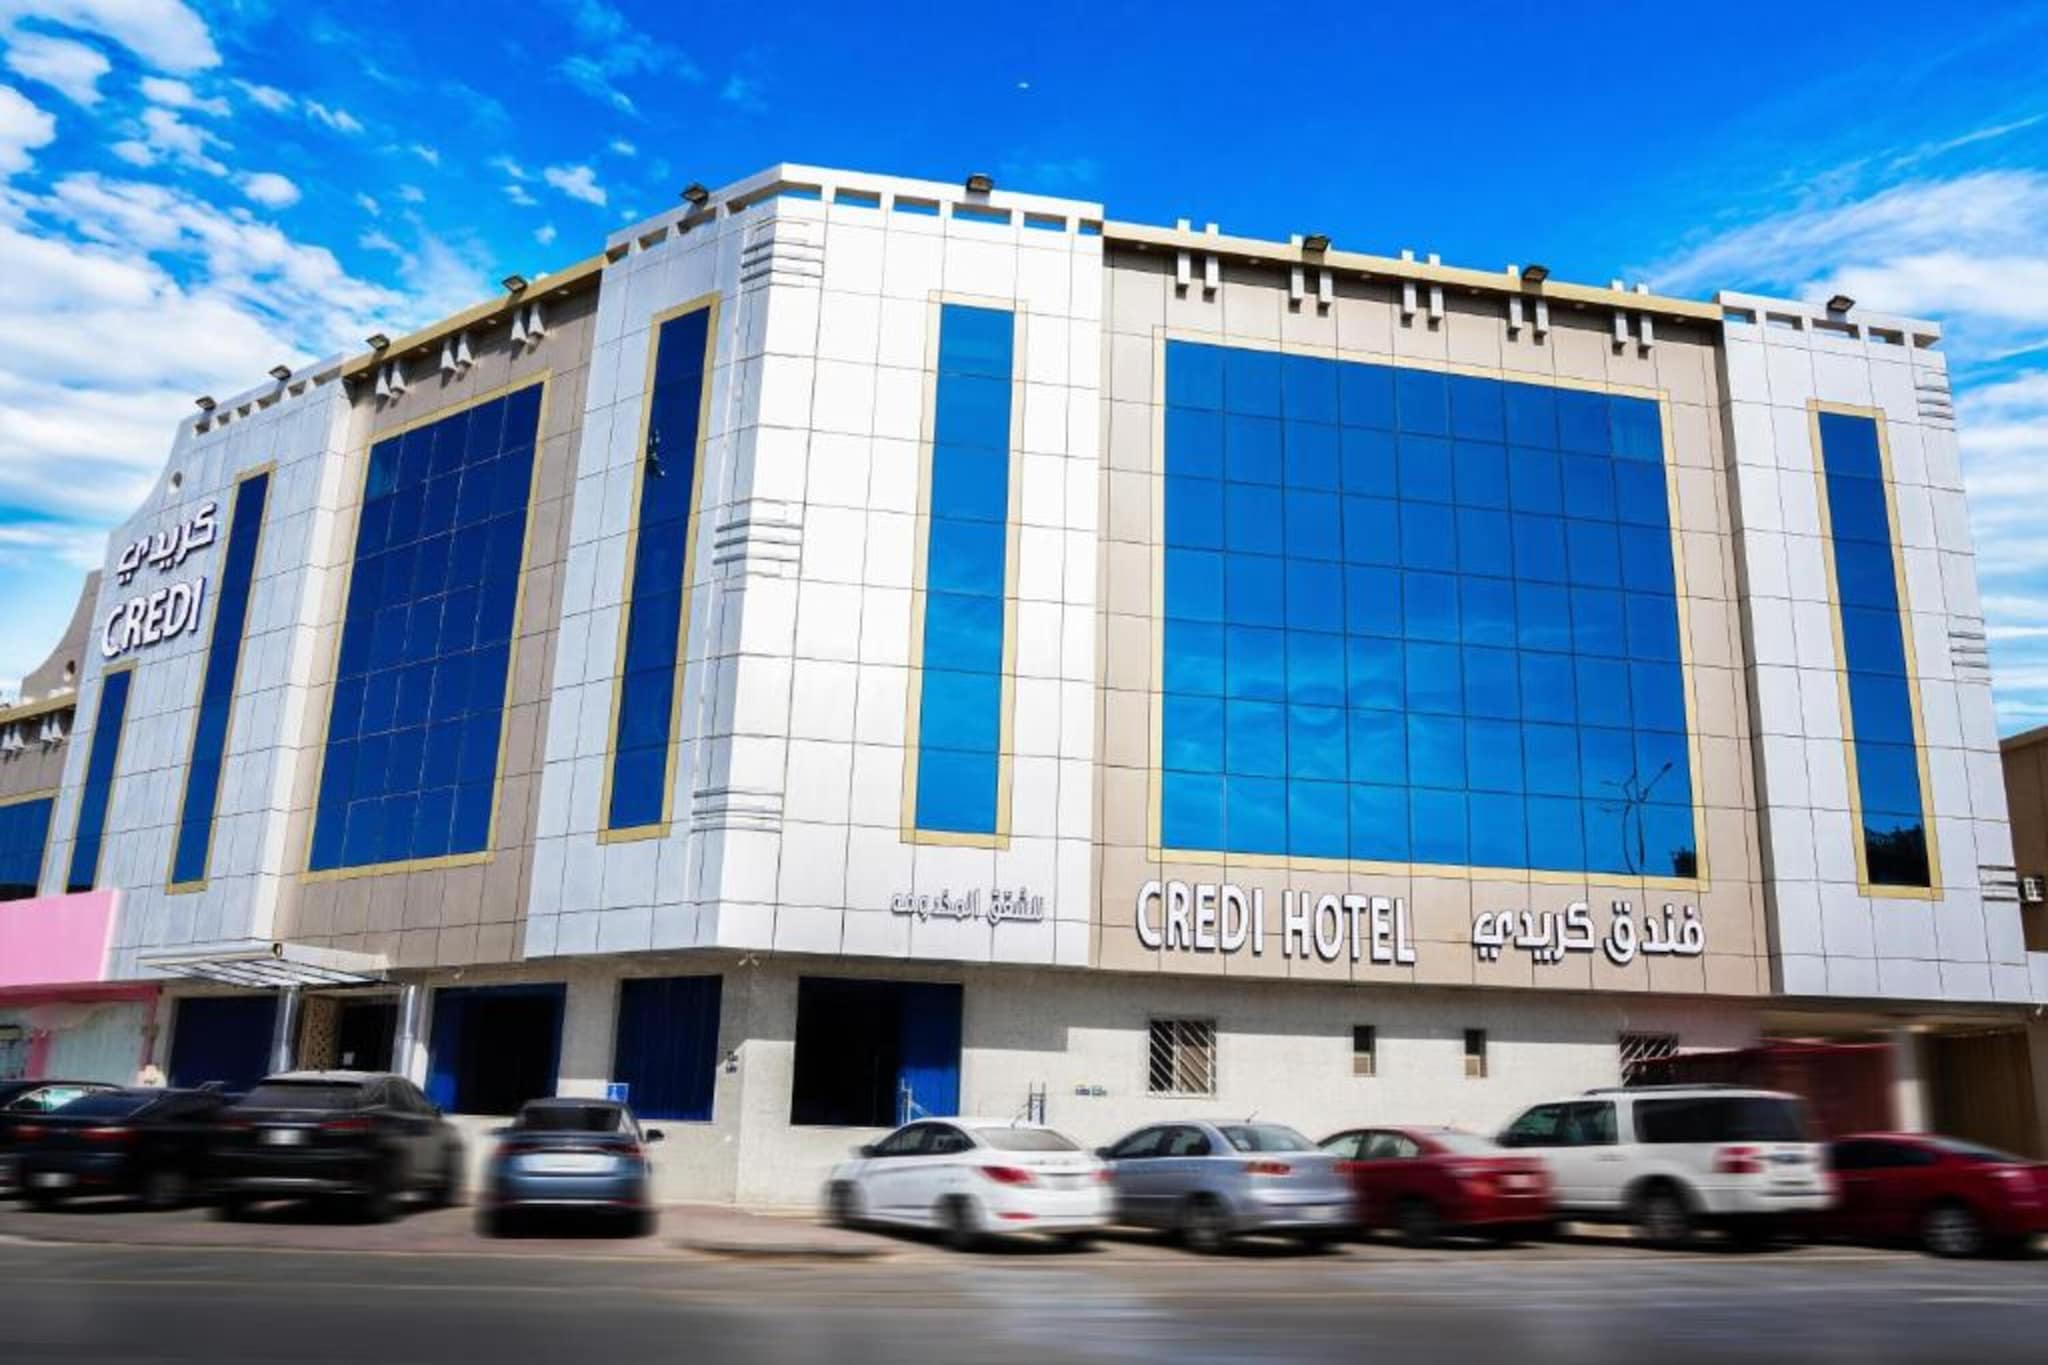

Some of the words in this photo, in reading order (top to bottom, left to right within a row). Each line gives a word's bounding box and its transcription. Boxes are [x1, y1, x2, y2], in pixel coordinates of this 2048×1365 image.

[117, 502, 217, 587] كريدي
[102, 577, 207, 661] CREDI
[1136, 880, 1264, 957] CREDI
[1282, 889, 1417, 967] HOTEL
[1472, 901, 1597, 965] كريدي
[1603, 900, 1706, 968] فندق
